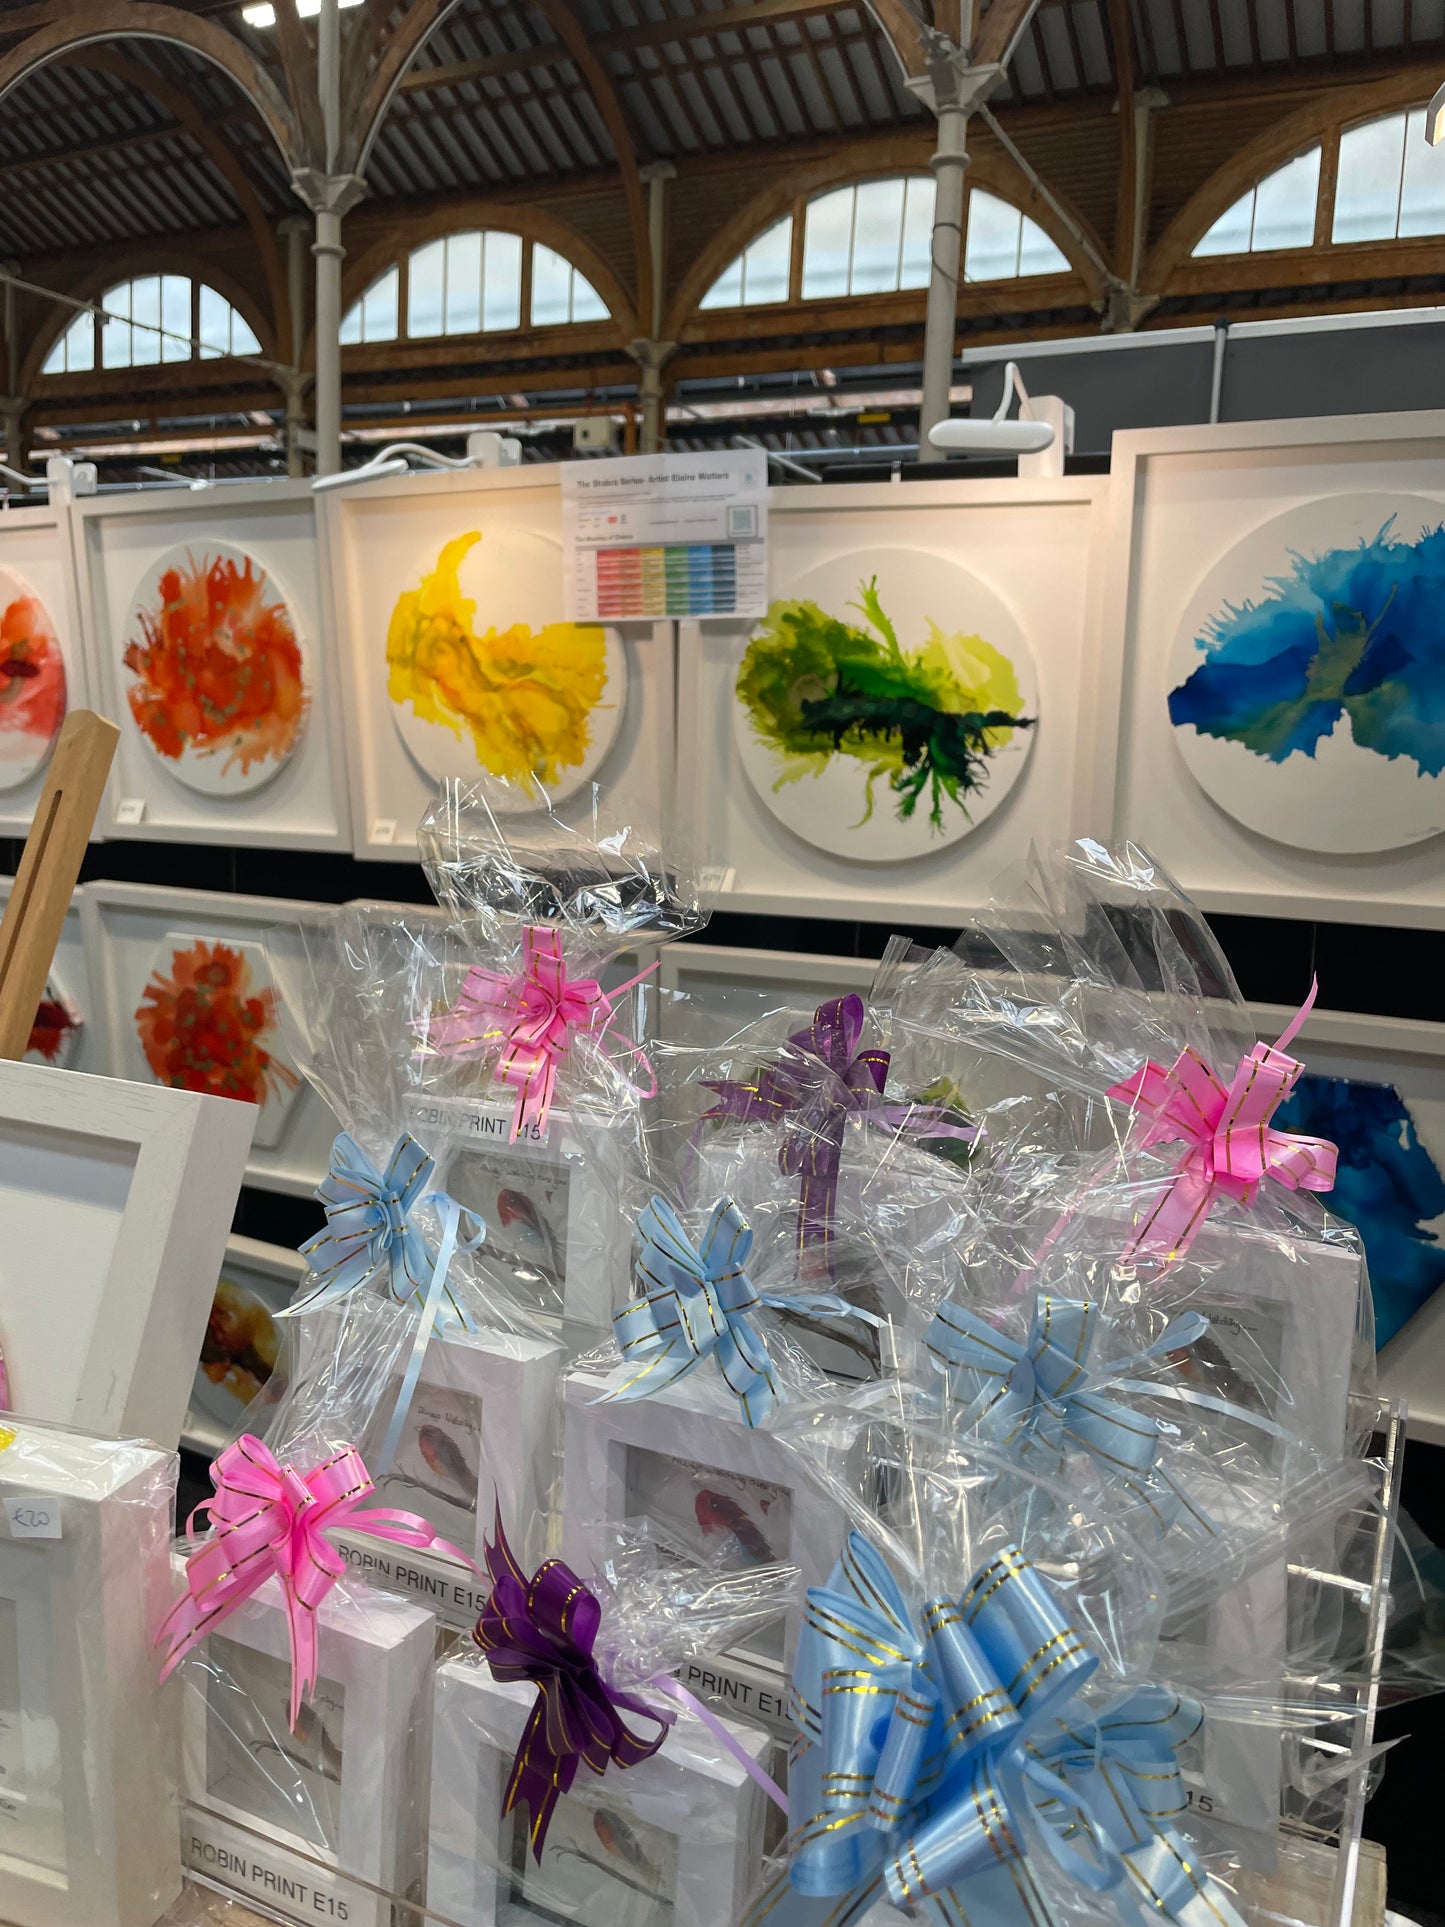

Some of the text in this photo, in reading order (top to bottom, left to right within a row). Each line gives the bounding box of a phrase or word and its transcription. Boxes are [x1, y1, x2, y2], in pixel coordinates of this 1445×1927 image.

[458, 1113, 507, 1135] PRINT
[516, 1122, 541, 1141] 15
[12, 1507, 50, 1527] €20
[395, 1566, 449, 1598] PRINT
[453, 1586, 486, 1612] E15
[688, 1665, 753, 1703] PRINT
[191, 1837, 349, 1921] ROBIN PRINT E15
